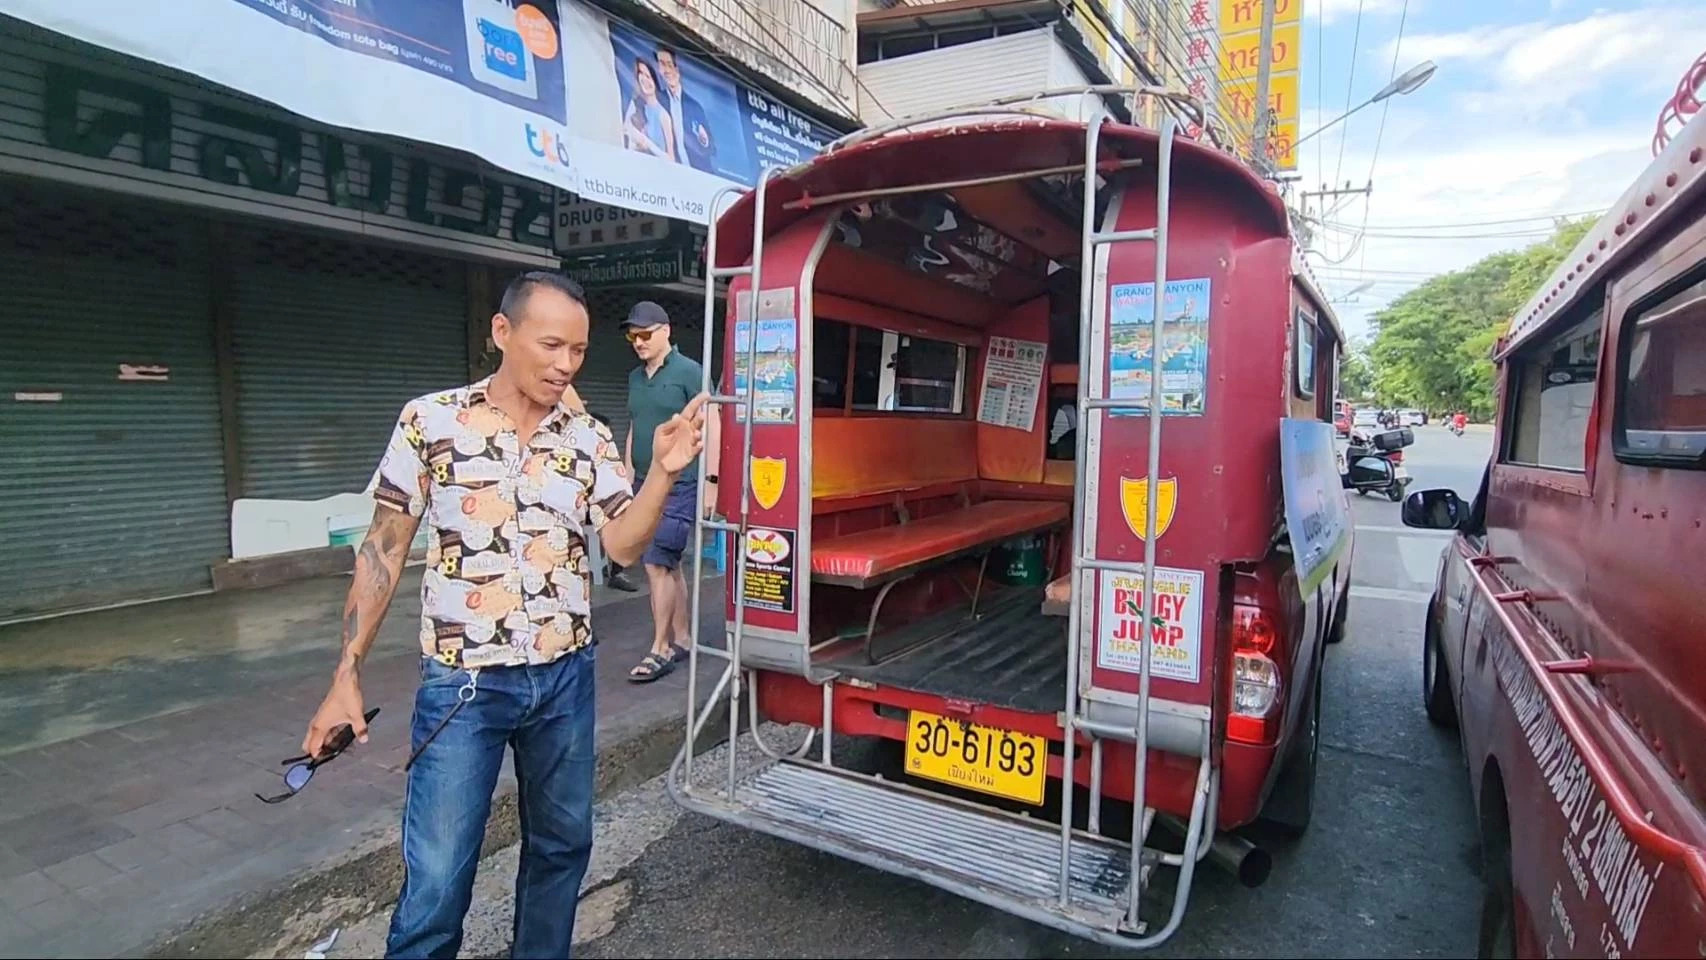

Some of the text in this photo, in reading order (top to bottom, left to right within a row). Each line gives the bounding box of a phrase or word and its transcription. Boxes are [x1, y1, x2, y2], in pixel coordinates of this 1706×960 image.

[378, 39, 399, 56] bag
[747, 90, 768, 112] ttb
[770, 104, 785, 121] all
[787, 110, 811, 133] free
[525, 122, 570, 168] ttb
[584, 178, 667, 207] ttbbank.com
[680, 199, 704, 216] 1428
[559, 206, 604, 228] DRUG
[1115, 282, 1203, 298] GRAND ANYON
[1006, 569, 1029, 579] Chang
[1113, 620, 1185, 648] JUMP
[1109, 638, 1189, 661] THAAND
[916, 720, 1036, 777] 30-6193
[947, 764, 995, 787] เชียงใหม่
[1581, 799, 1606, 860] 2
